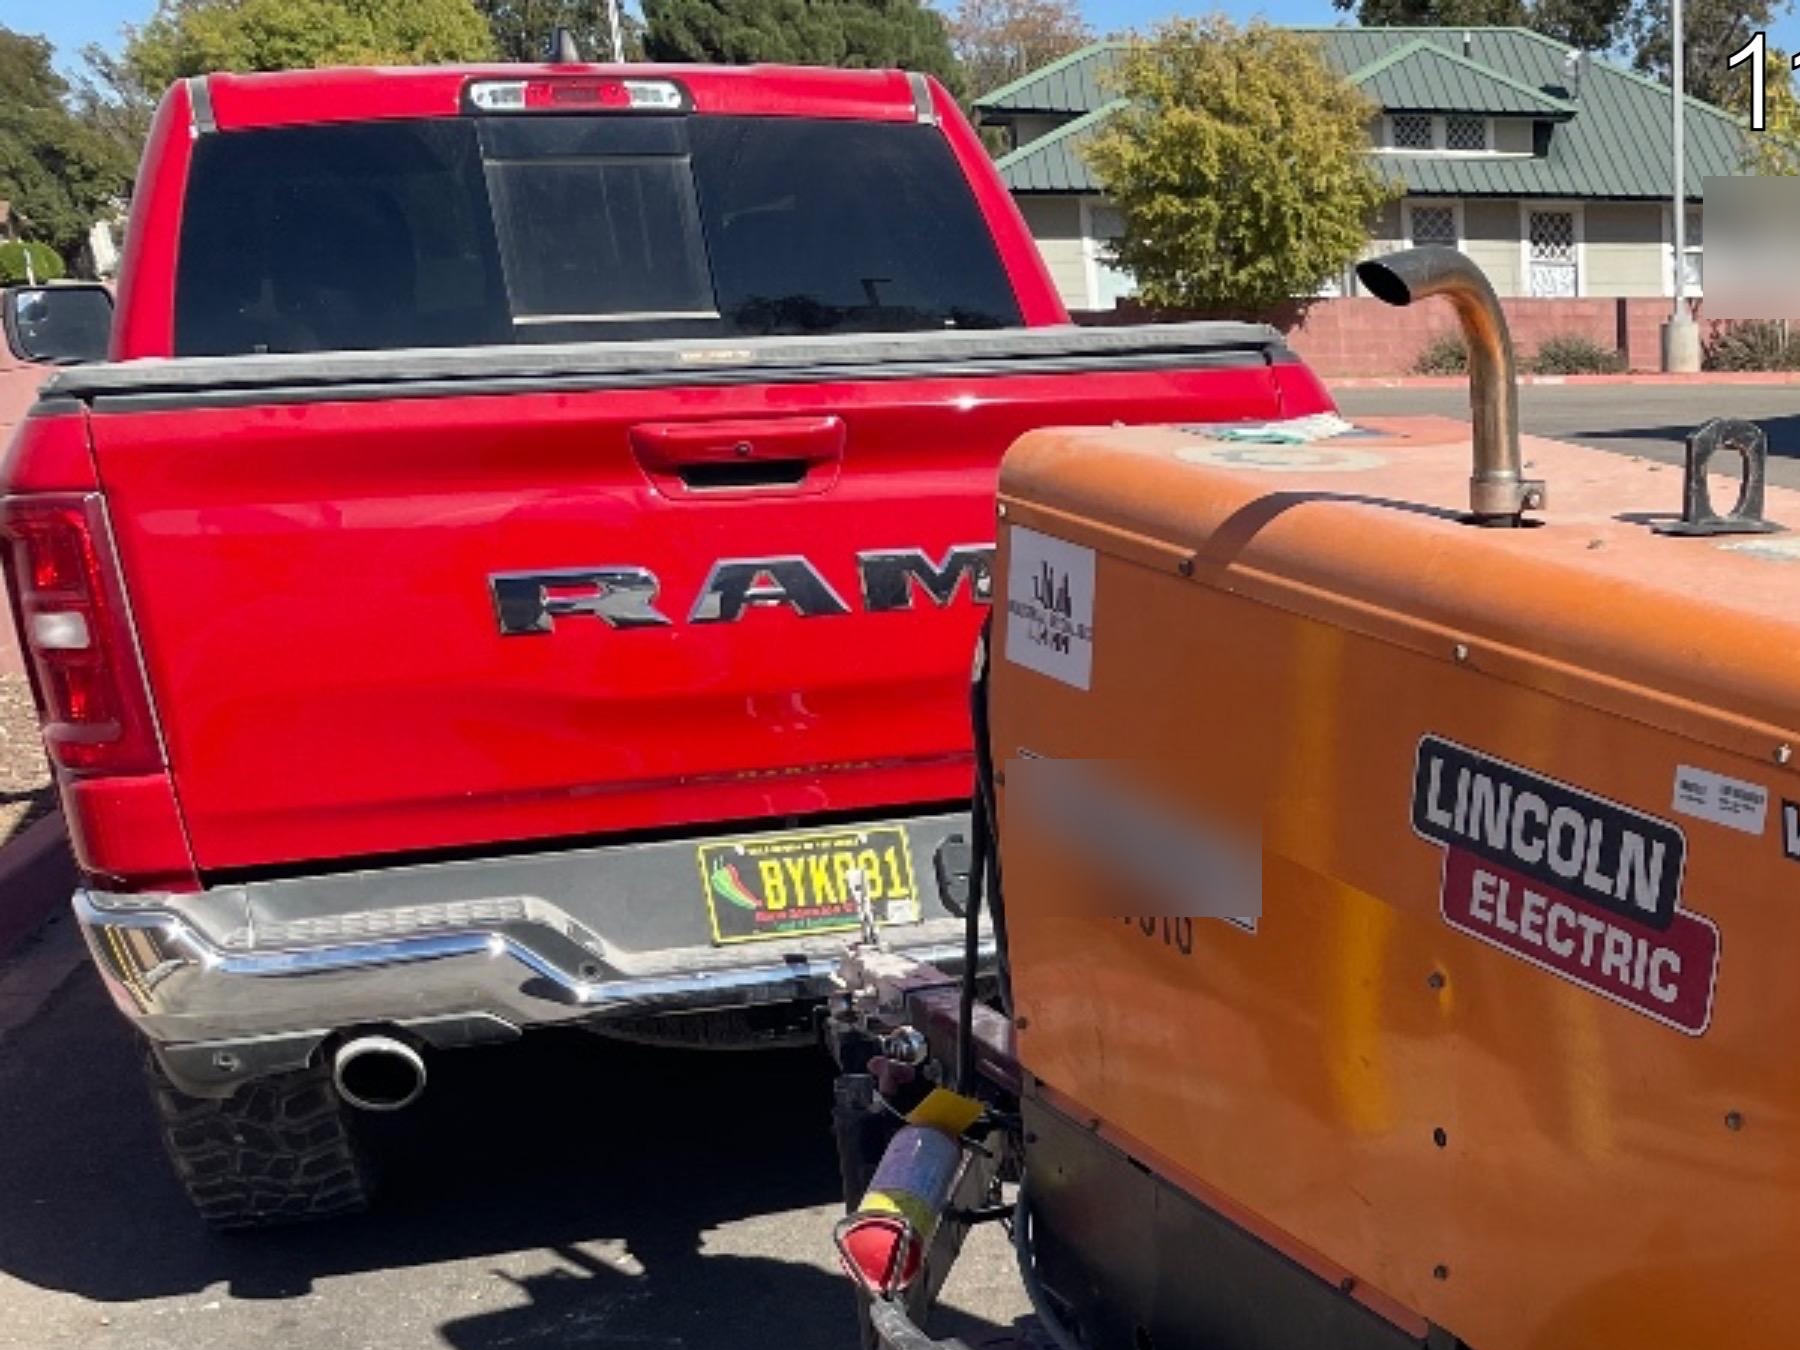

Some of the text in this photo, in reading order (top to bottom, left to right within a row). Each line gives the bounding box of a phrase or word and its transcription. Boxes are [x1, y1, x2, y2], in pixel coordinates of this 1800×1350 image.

[488, 543, 999, 635] RAM
[1426, 757, 1666, 913] LINCOLN
[1469, 869, 1682, 1004] ELECTRIC
